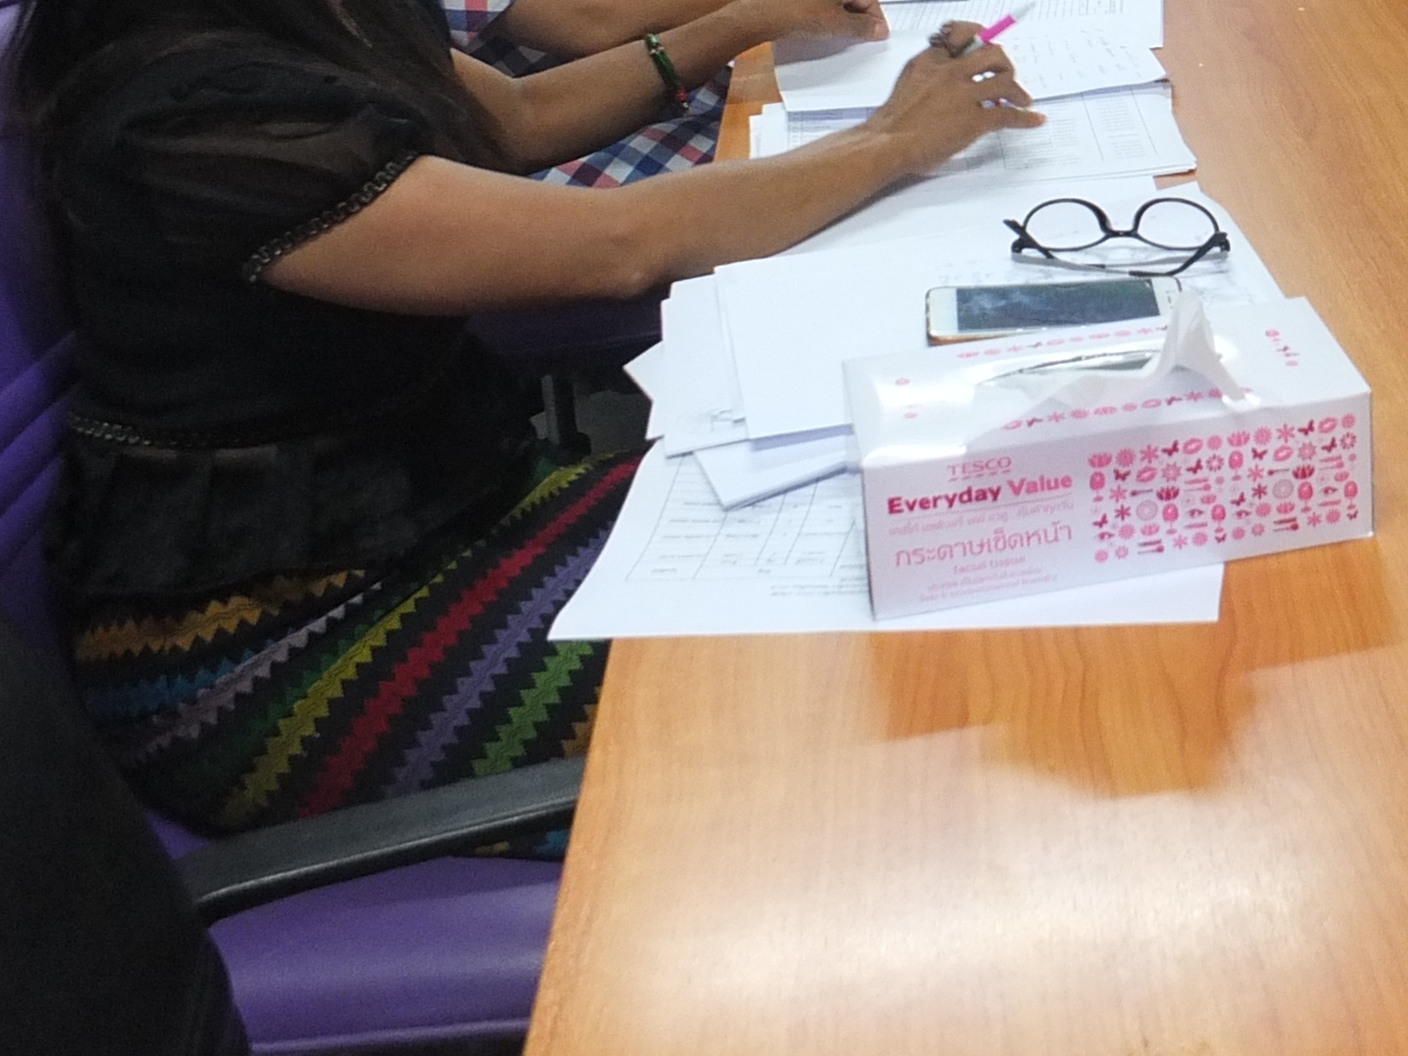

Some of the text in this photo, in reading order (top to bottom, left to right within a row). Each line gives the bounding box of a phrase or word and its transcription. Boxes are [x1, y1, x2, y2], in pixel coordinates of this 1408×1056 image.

[948, 456, 1013, 477] TESCO
[887, 473, 1073, 515] Everyday Value
[895, 519, 1073, 568] กระดาษเช็ดหน้า
